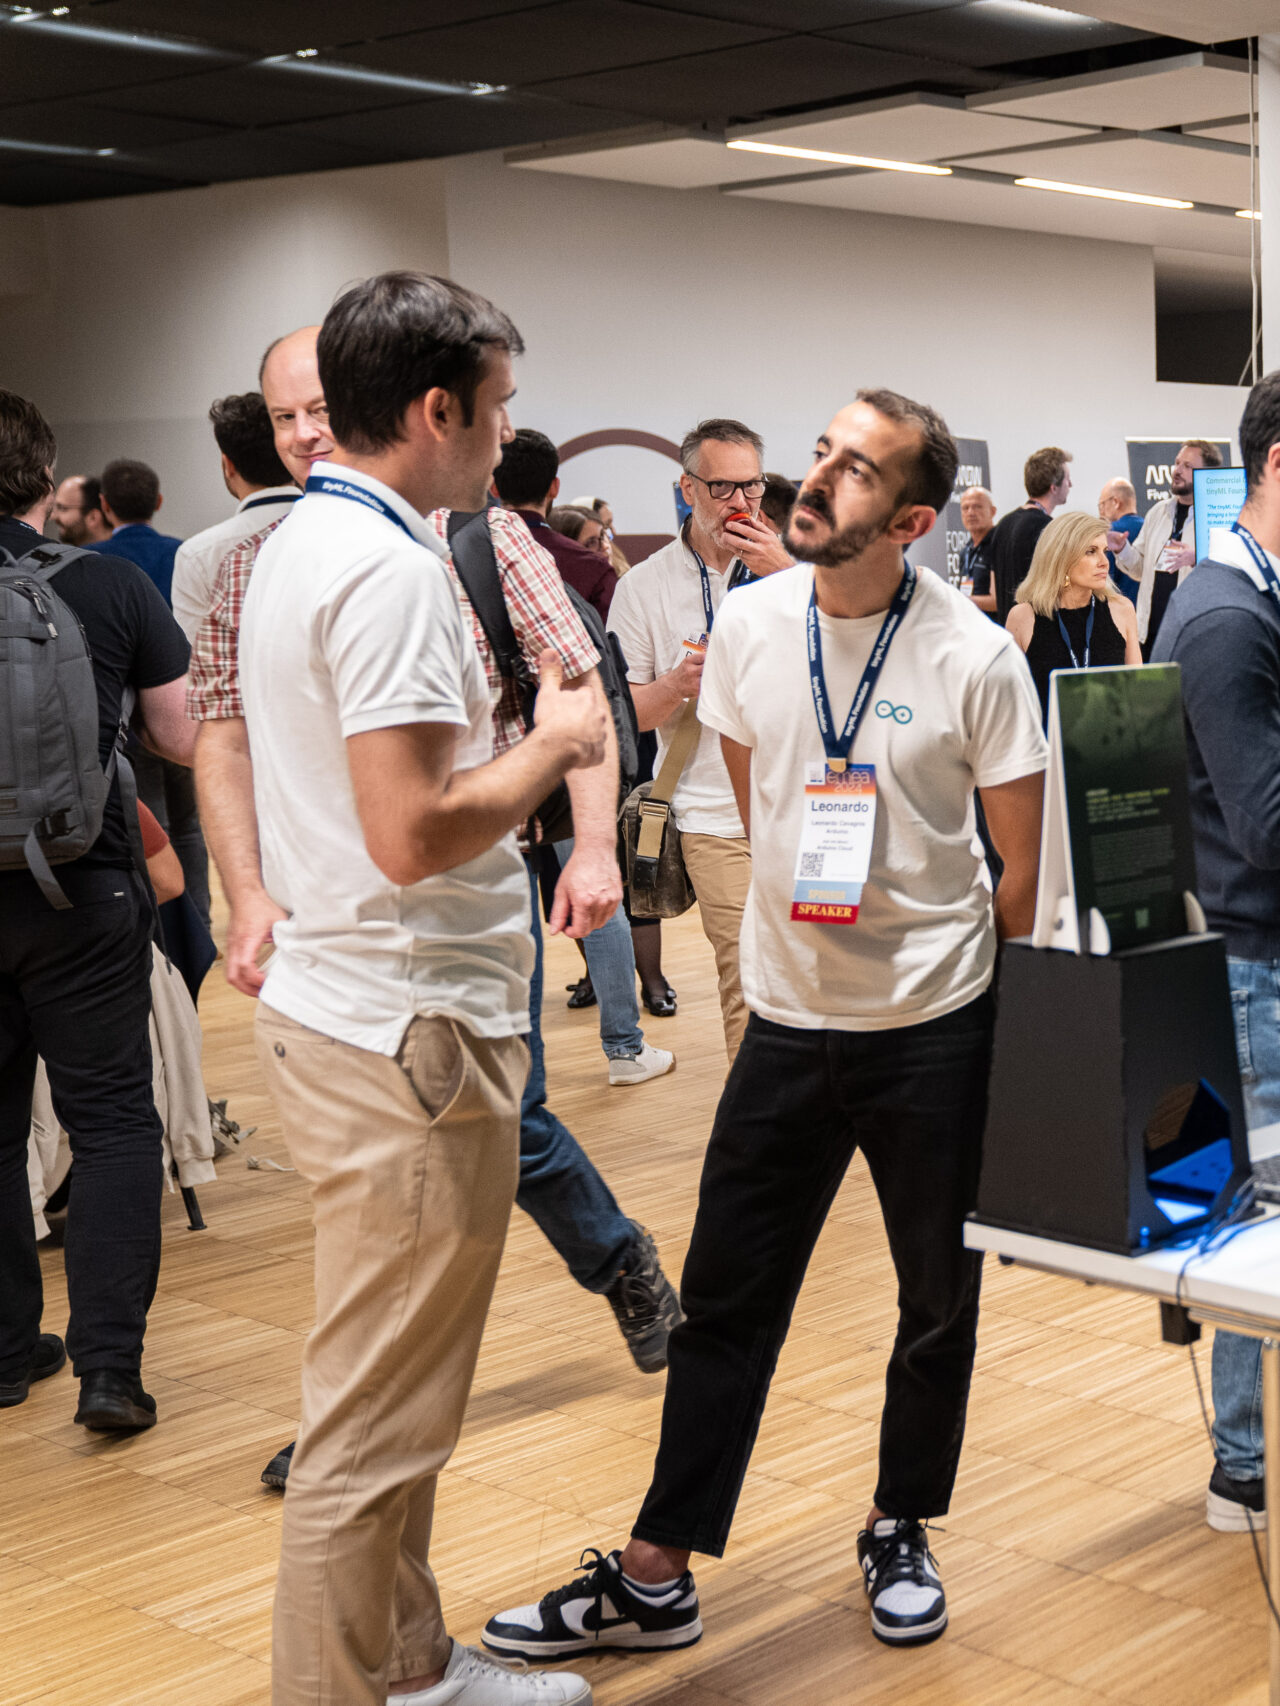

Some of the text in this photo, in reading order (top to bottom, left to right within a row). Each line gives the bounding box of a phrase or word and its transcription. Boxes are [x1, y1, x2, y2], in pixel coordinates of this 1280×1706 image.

[851, 681, 870, 720] Foundation
[811, 801, 869, 813] Leonardo
[797, 903, 853, 918] SPEAKER
